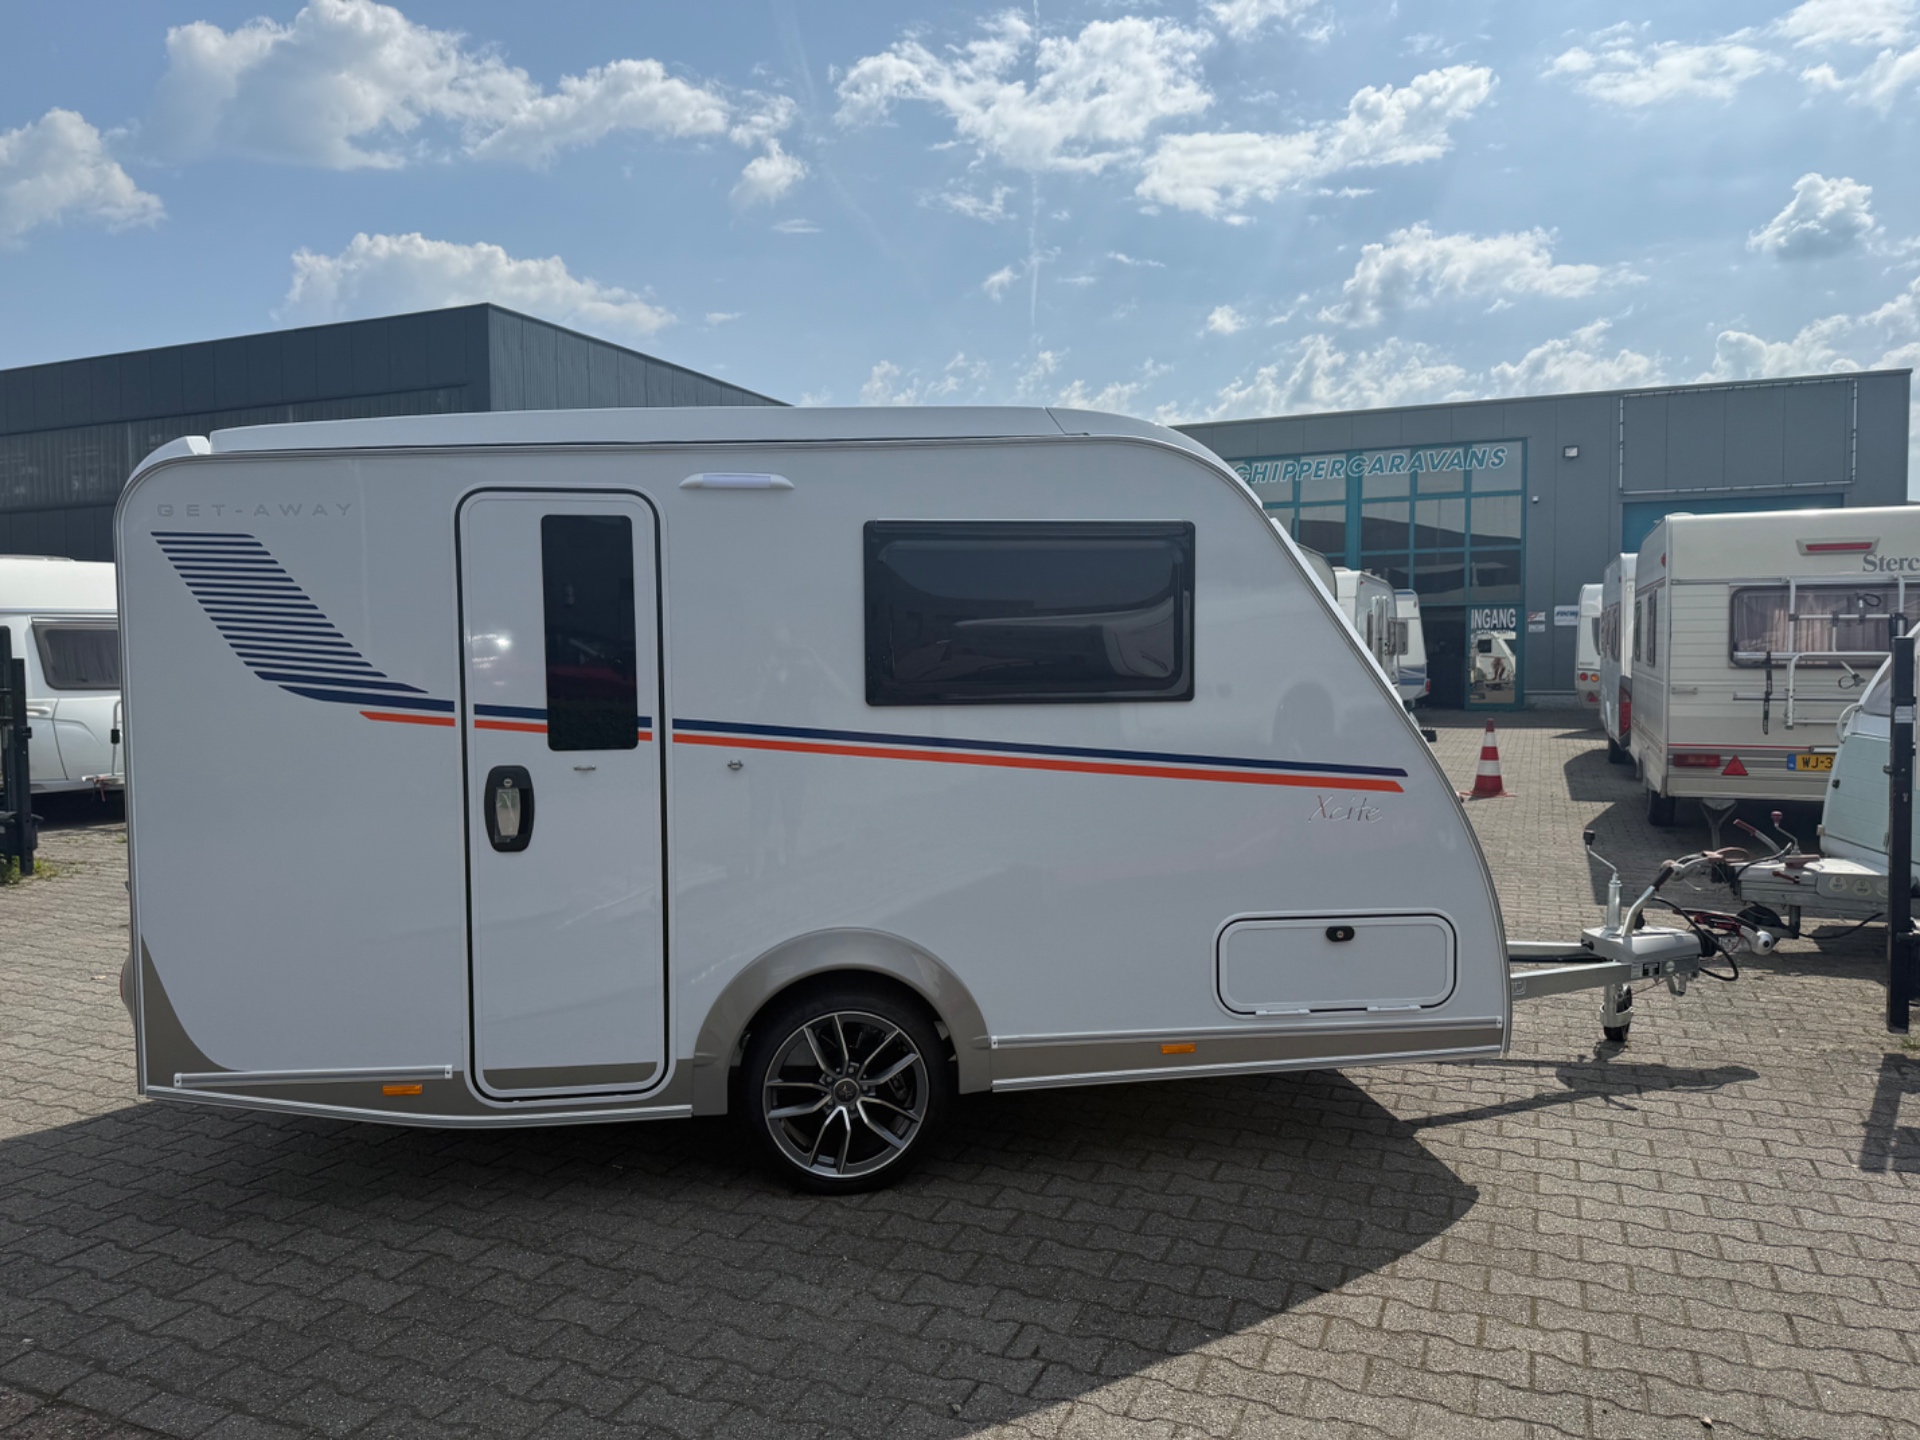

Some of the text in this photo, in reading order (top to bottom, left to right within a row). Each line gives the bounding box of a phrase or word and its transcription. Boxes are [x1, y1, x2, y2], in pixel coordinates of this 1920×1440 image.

[156, 503, 352, 518] GET-AWAY
[1862, 552, 1920, 573] Sterc
[1470, 608, 1517, 629] INGANG
[1307, 794, 1383, 824] Xcite
